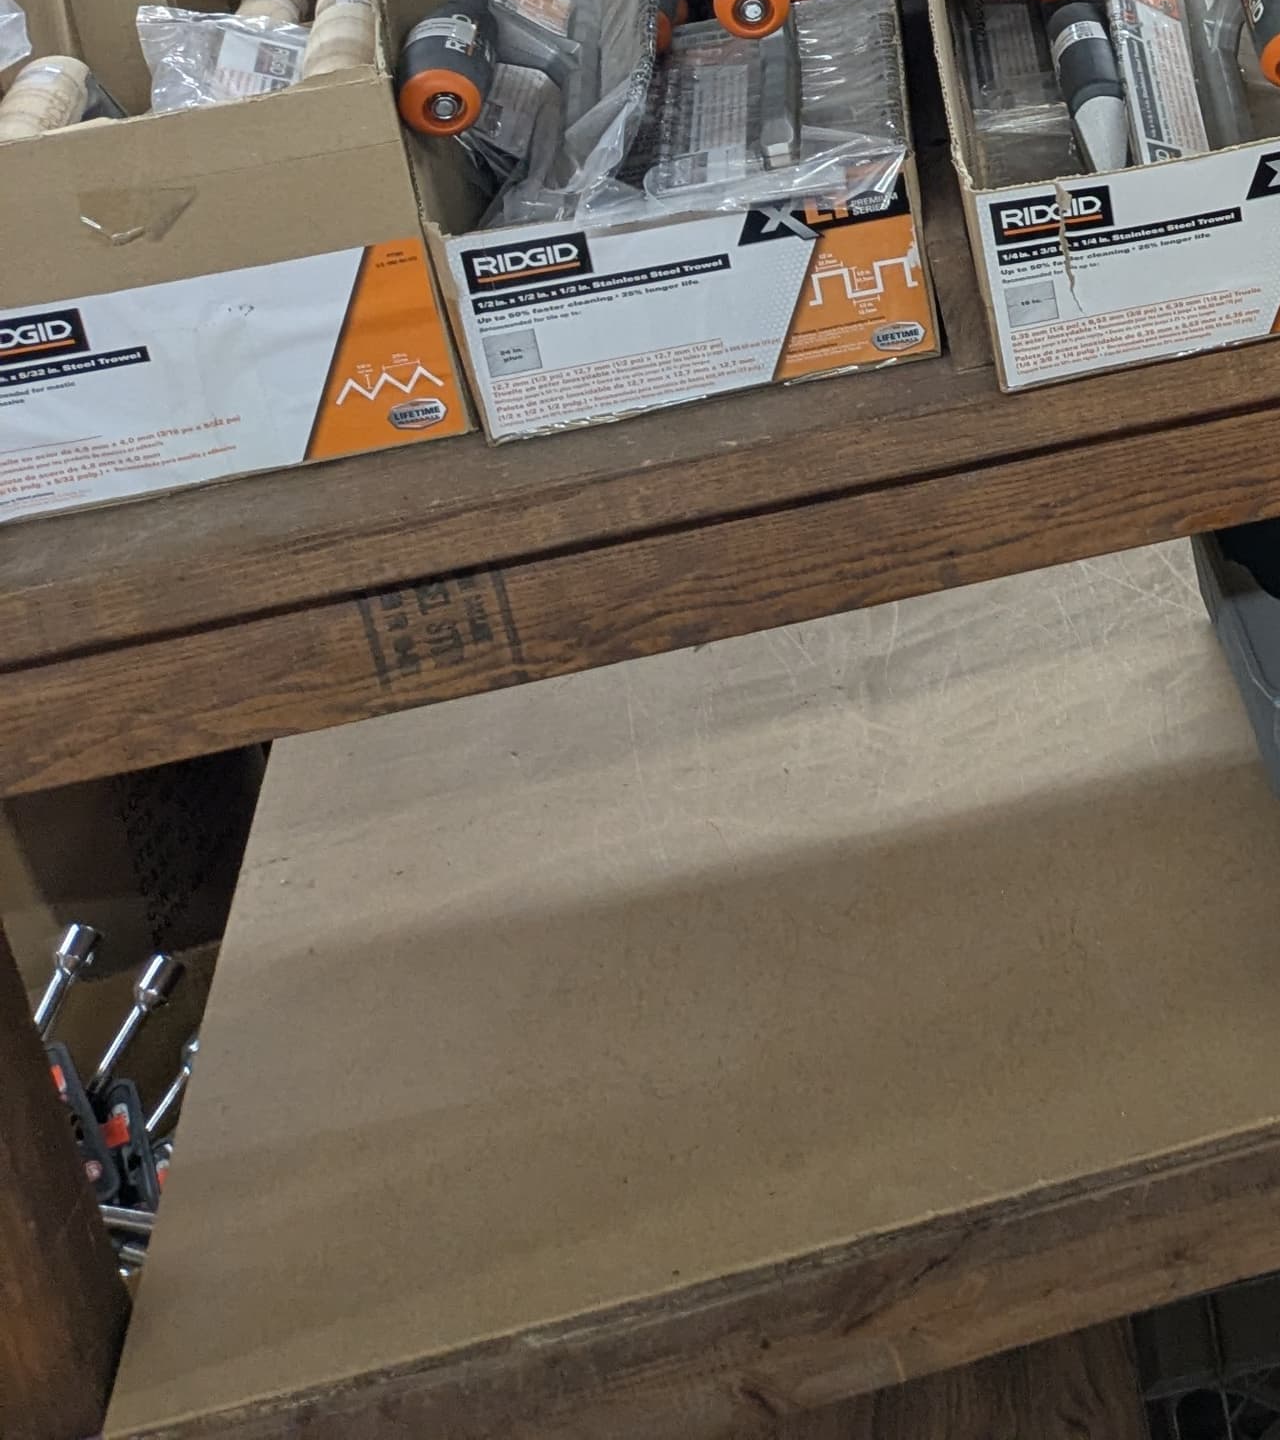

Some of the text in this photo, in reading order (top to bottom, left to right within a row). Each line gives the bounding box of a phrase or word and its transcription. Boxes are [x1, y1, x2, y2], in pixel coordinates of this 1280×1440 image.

[1112, 212, 1236, 242] Stainless Steel Trowel
[472, 242, 579, 278] RIDGID
[591, 259, 723, 290] Stainless Steel Trowel
[566, 283, 679, 309] cleaning longer
[876, 328, 921, 343] LIFETIME
[62, 351, 142, 373] Steel Trowel
[392, 405, 442, 424] LIFETIME
